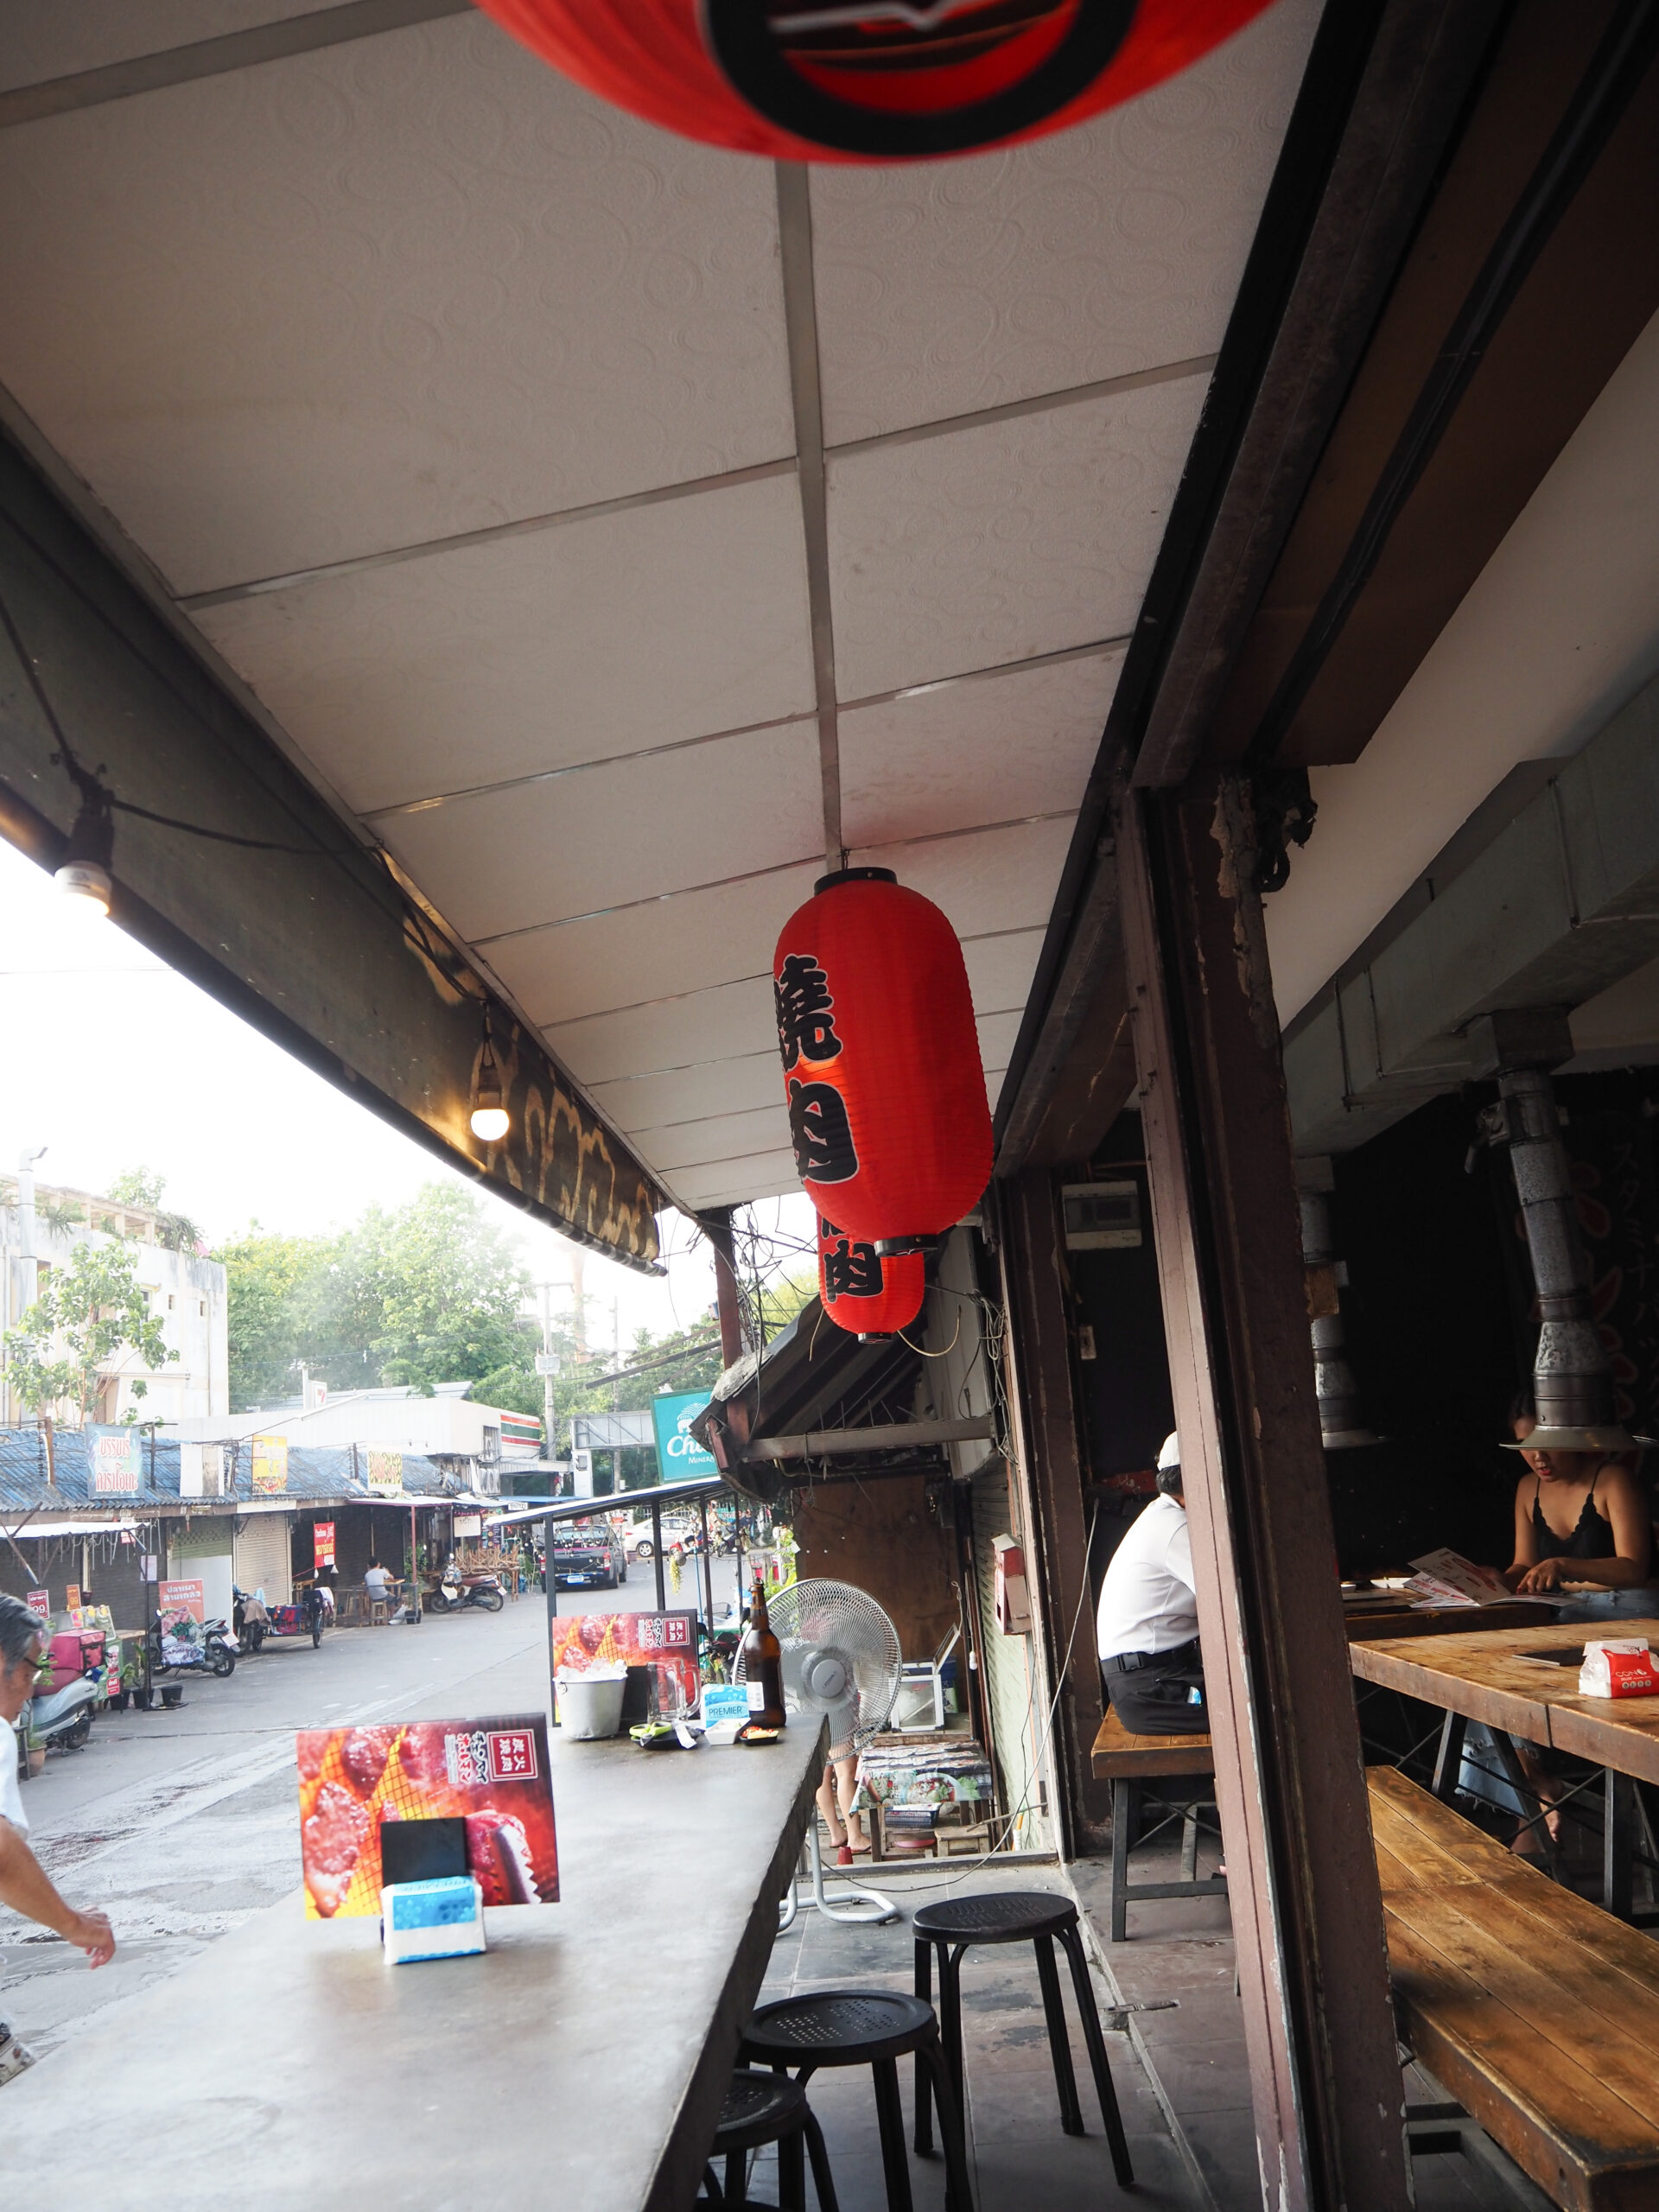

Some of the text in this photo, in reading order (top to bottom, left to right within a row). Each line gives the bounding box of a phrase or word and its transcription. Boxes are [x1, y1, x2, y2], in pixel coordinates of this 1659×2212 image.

[773, 953, 861, 1185] 焼肉
[821, 1215, 885, 1304] 肉
[709, 1706, 742, 1716] PREMIER
